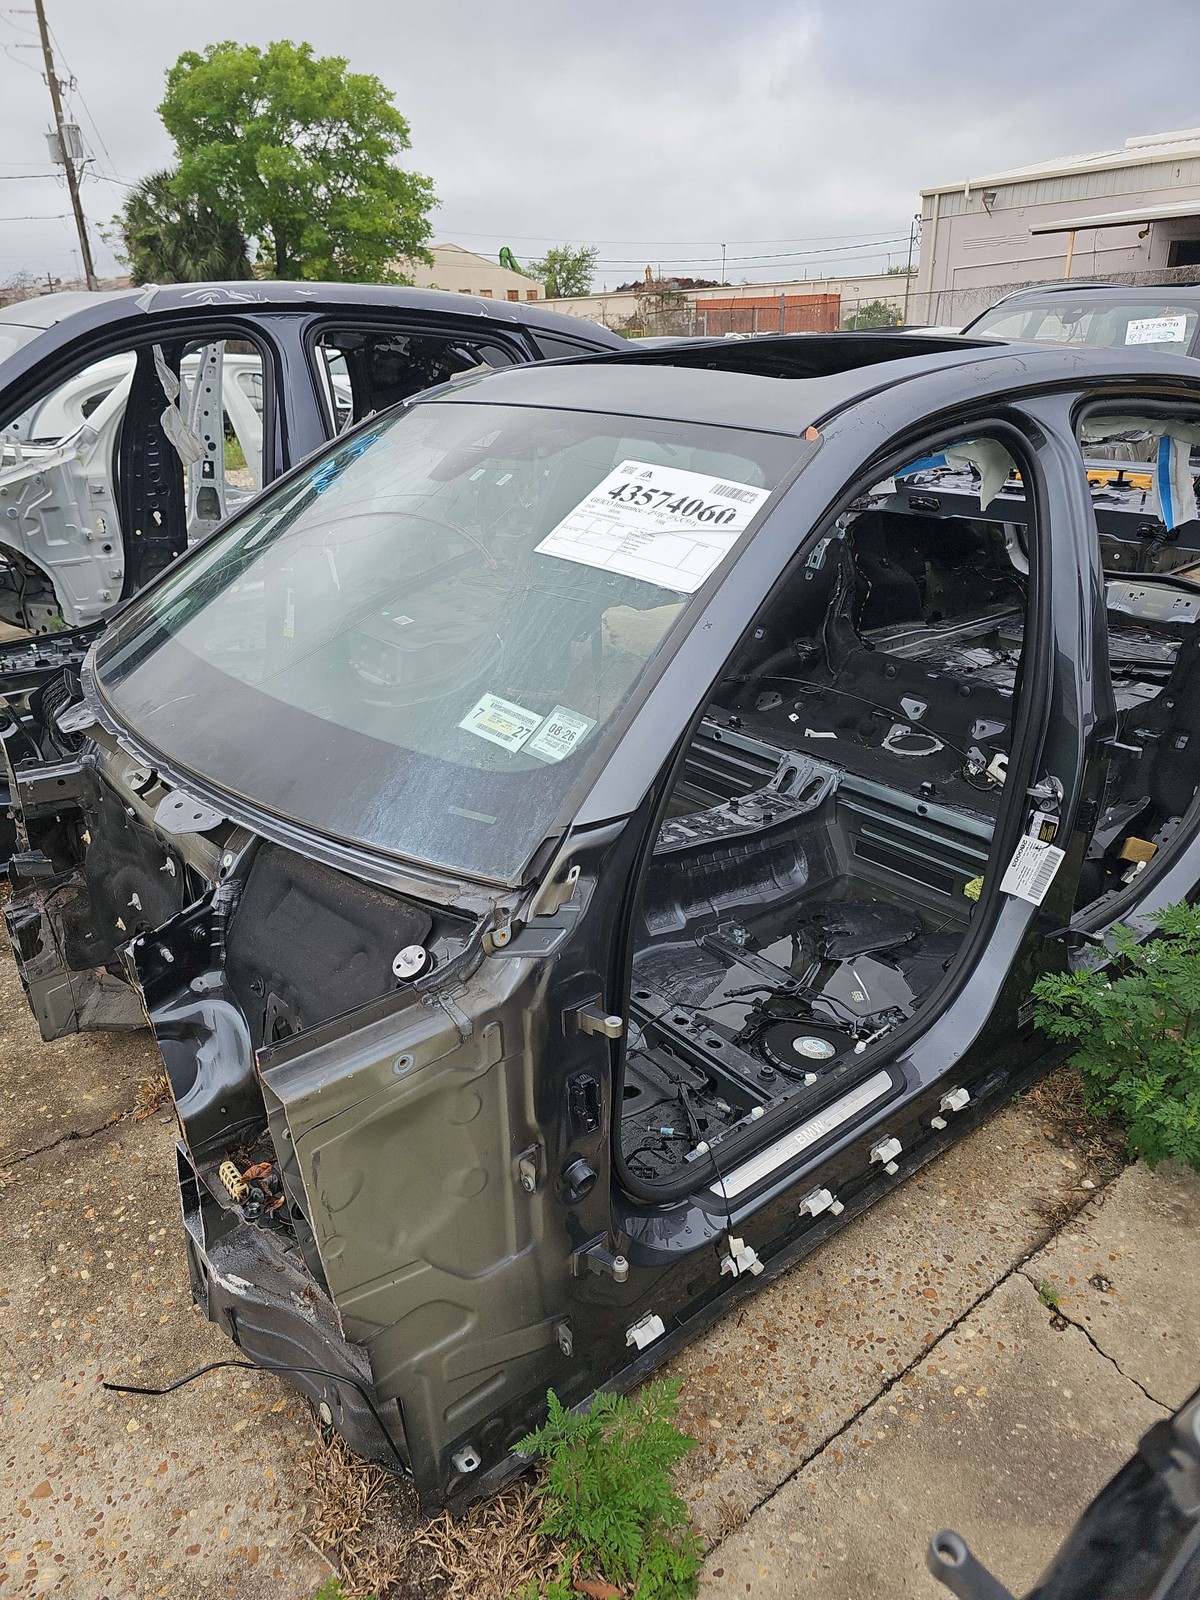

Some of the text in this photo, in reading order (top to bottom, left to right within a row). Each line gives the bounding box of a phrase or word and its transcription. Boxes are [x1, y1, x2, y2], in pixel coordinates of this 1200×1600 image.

[590, 497, 614, 506] GEICO
[613, 502, 643, 513] Insurance
[608, 483, 736, 524] 43574060
[473, 708, 485, 719] 7
[511, 725, 531, 740] 27
[794, 1119, 826, 1145] BMW
